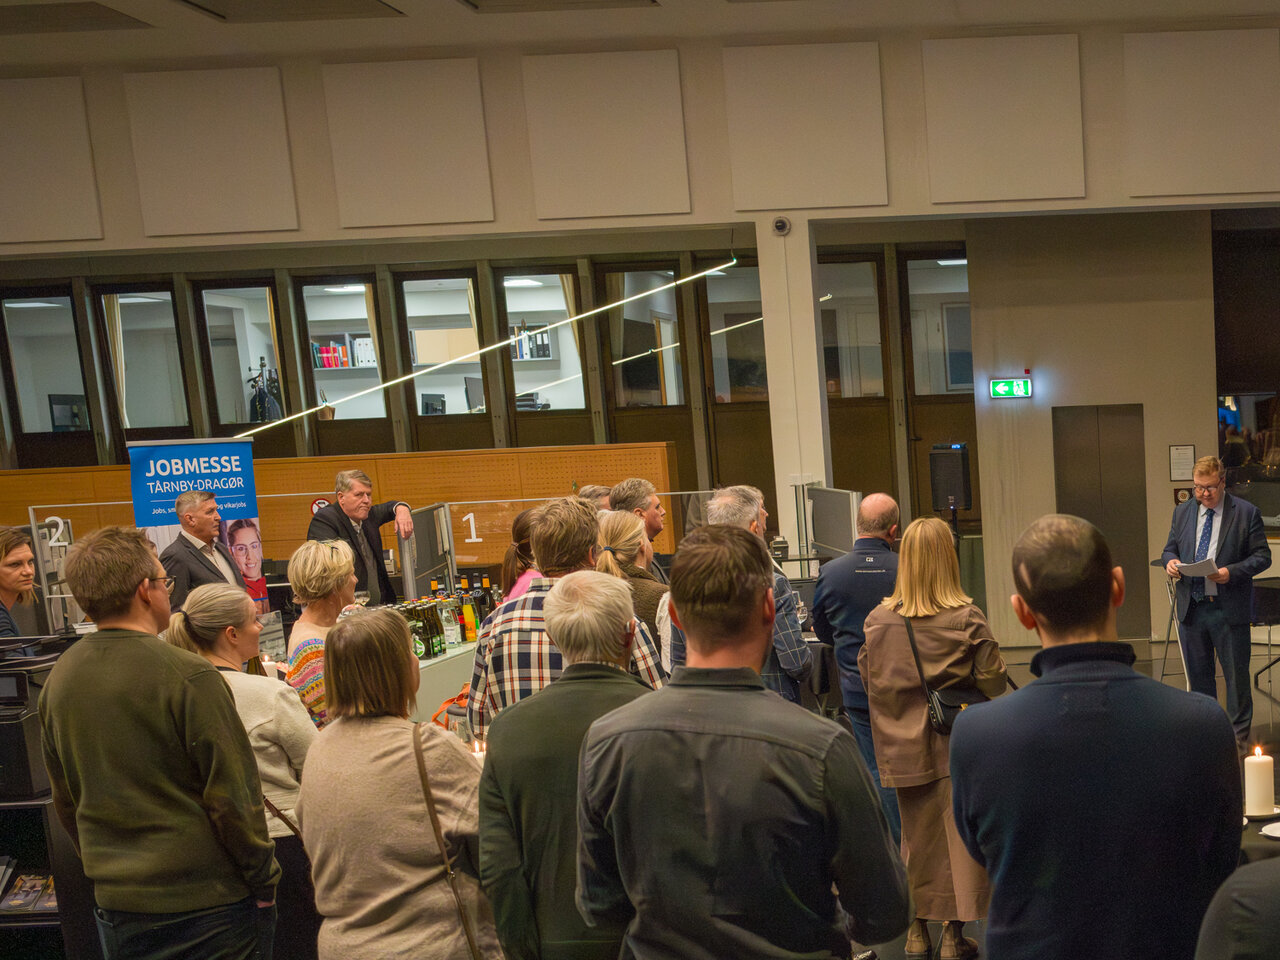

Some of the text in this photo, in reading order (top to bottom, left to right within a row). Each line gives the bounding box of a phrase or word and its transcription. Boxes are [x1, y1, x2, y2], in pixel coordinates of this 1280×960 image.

[145, 456, 241, 477] JOBMESSE
[146, 477, 244, 494] TÅRNBY-DRAGØR
[151, 507, 167, 515] Jobs,
[44, 516, 69, 547] 2
[462, 512, 483, 543] 1
